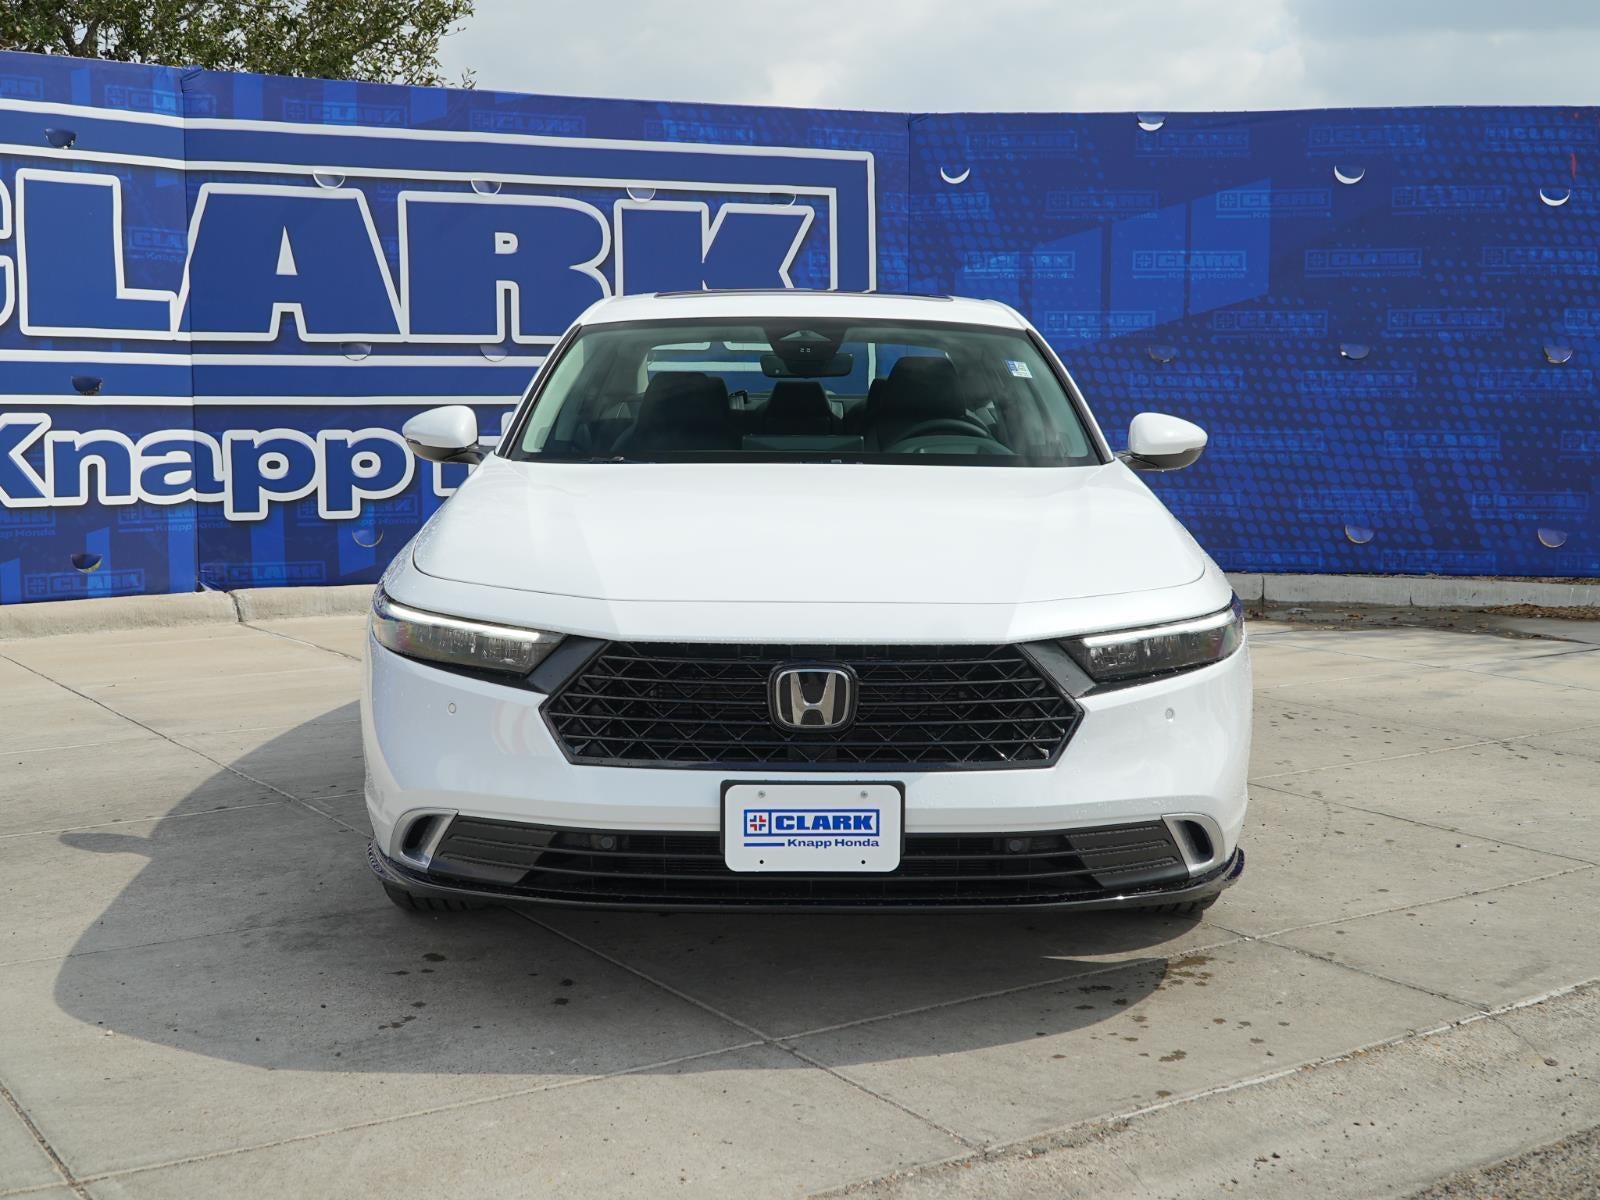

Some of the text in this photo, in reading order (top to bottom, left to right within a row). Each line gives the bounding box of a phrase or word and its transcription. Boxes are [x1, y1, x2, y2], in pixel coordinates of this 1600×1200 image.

[0, 167, 816, 344] LARK
[1158, 255, 1242, 267] CLARK
[775, 815, 873, 830] CLARK
[787, 838, 880, 849] Knapp Honda
